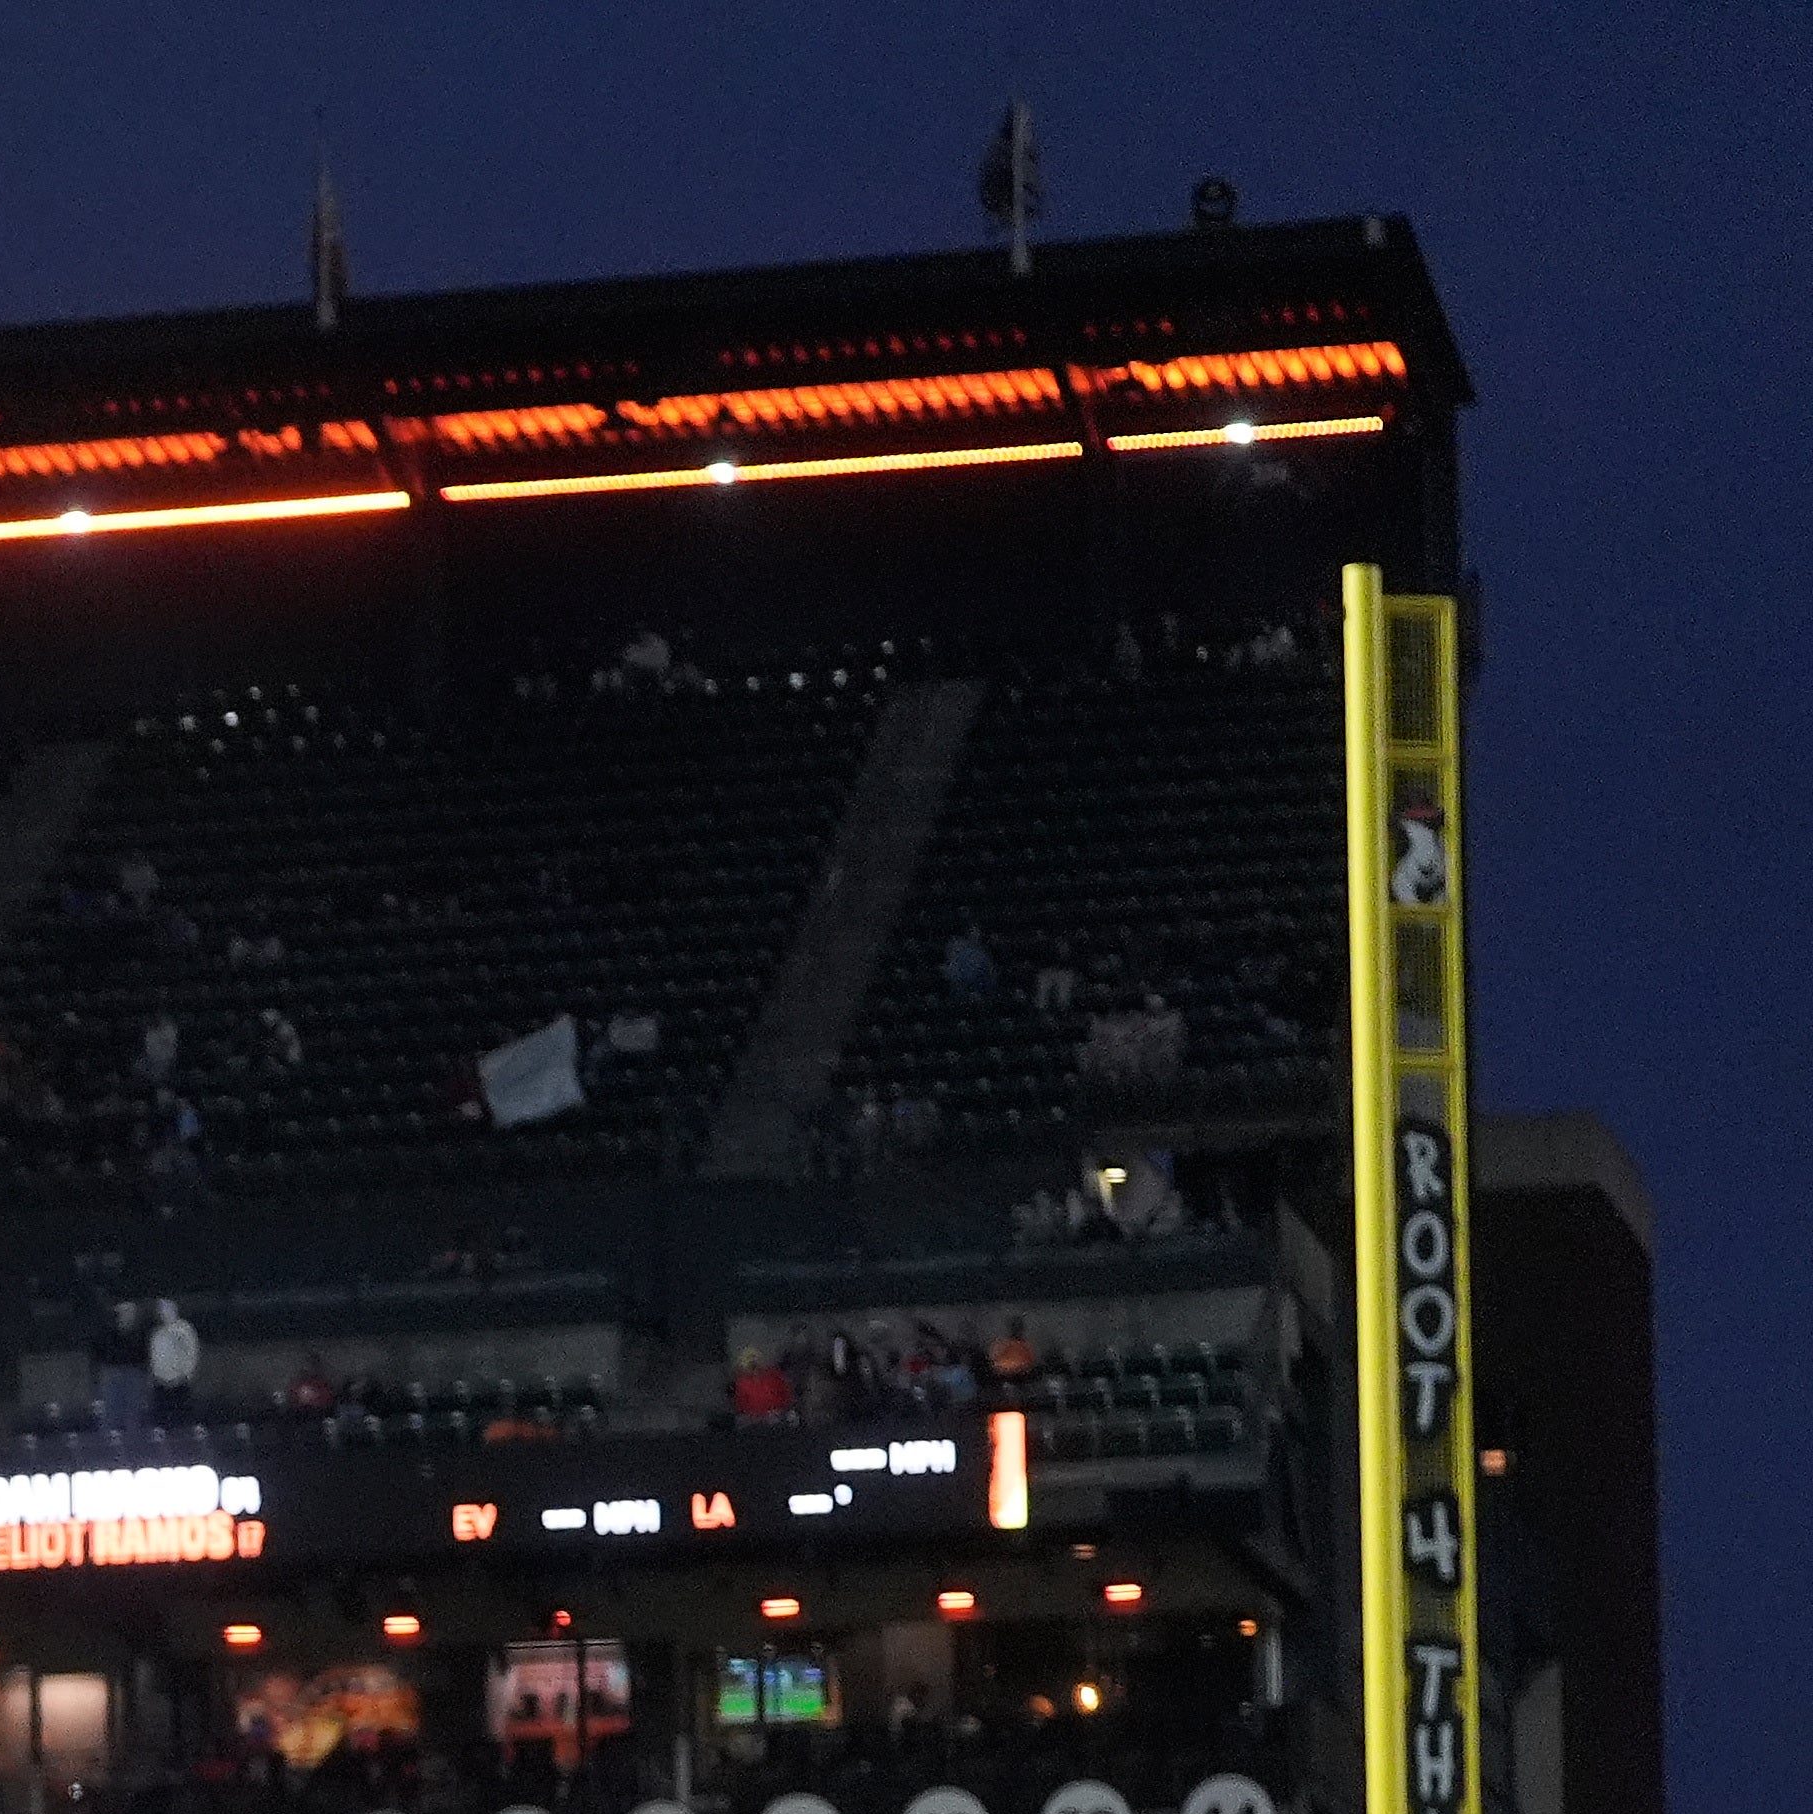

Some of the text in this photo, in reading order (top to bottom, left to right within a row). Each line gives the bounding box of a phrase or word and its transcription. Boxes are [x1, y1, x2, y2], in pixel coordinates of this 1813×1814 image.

[1401, 1131, 1455, 1434] ROOT
[89, 1511, 234, 1566] RAMOS
[452, 1502, 497, 1541] EV
[691, 1492, 736, 1529] LA
[1408, 1501, 1458, 1581] 4
